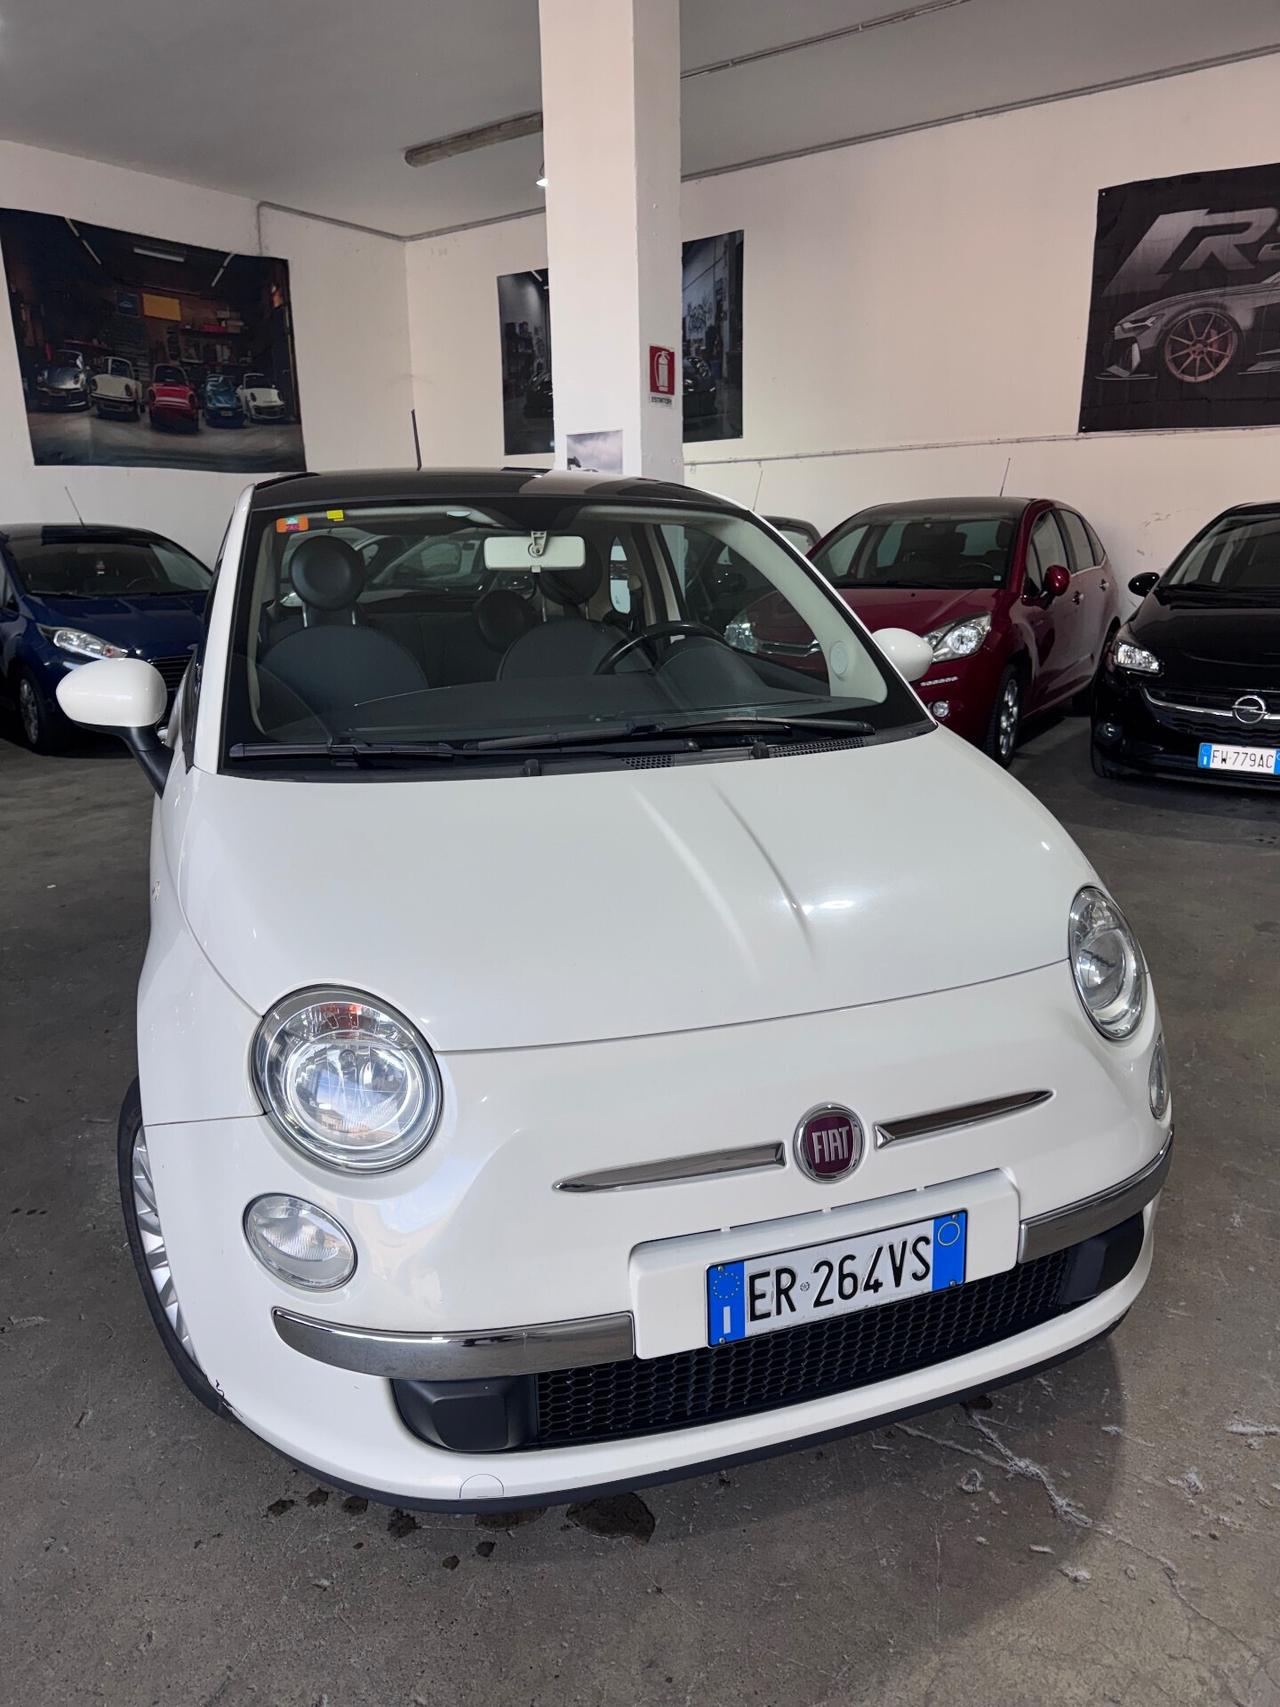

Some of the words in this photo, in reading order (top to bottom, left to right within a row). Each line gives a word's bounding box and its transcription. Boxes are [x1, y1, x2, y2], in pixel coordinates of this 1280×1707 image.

[1212, 749, 1229, 765] FW
[1232, 751, 1274, 769] 779AC
[811, 1126, 850, 1164] FIAT
[749, 1267, 797, 1322] ER
[812, 1236, 931, 1308] 264VS
[723, 1305, 731, 1334] I
